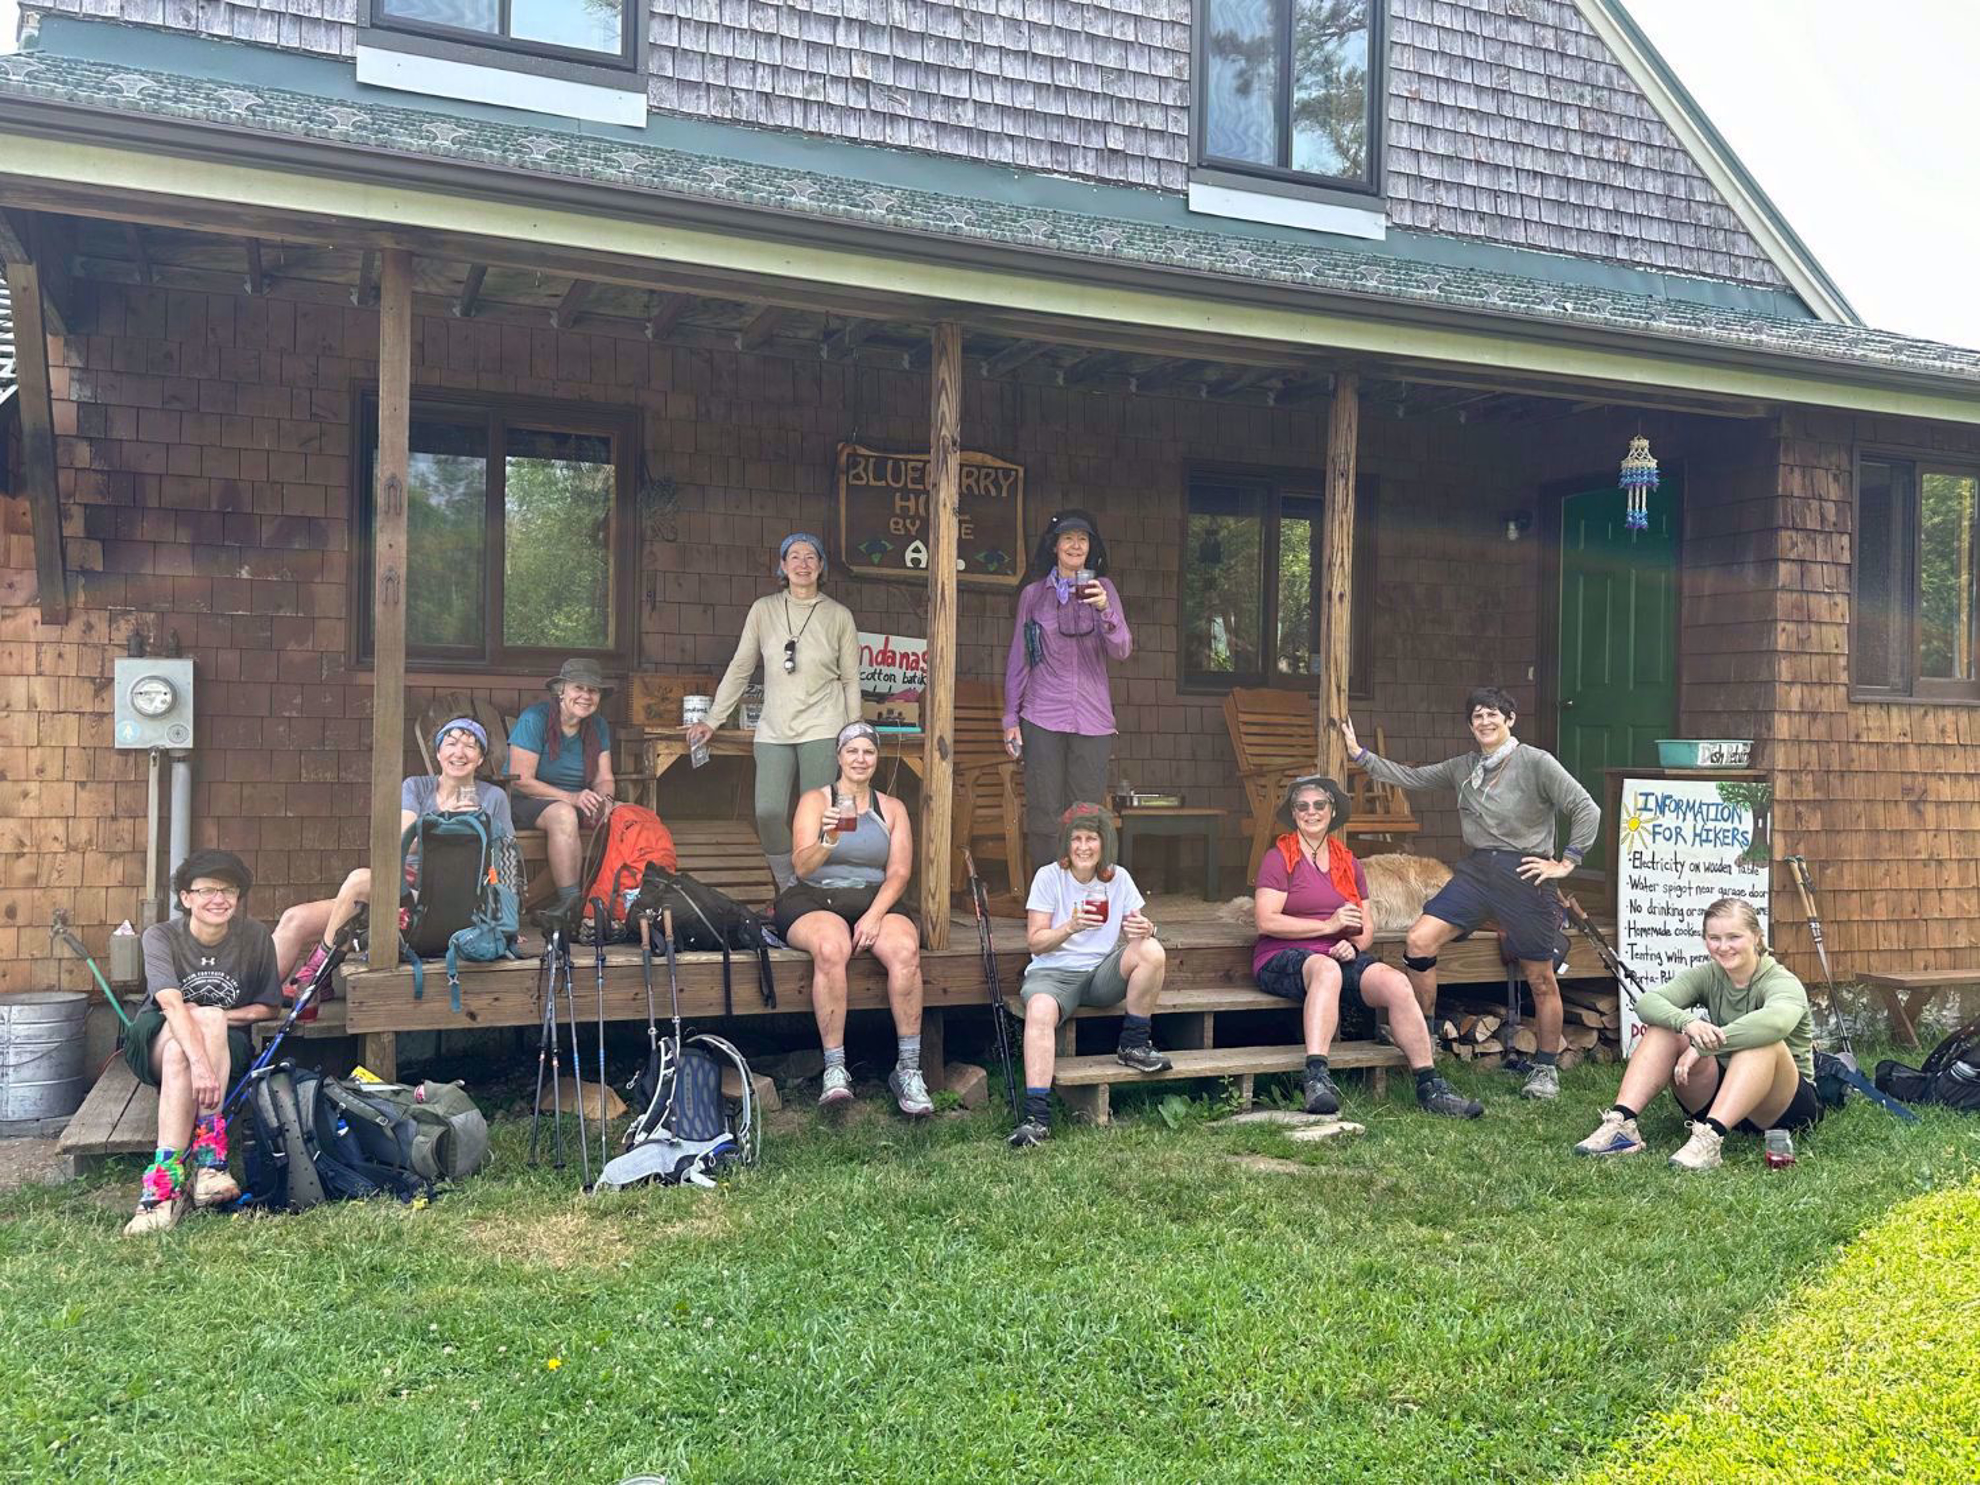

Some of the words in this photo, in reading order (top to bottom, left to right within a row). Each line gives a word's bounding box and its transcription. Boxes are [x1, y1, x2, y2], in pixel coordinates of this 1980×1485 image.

[849, 457, 1016, 497] BLUERRY
[889, 517, 921, 536] BY
[1637, 792, 1743, 825] INFORMATION
[1652, 824, 1687, 846] FOR
[1691, 824, 1750, 850] HIKERS
[1632, 851, 1686, 880] Electricity
[1689, 860, 1701, 873] on
[1629, 875, 1660, 893] Water
[1662, 880, 1693, 899] spigot
[1696, 886, 1715, 896] near
[1748, 883, 1768, 898] door
[1629, 899, 1643, 915] No
[1646, 898, 1685, 923] drinking
[1686, 907, 1697, 918] or
[1627, 920, 1672, 939] Homemade
[1626, 943, 1664, 967] Tenting
[1664, 946, 1688, 966] with
